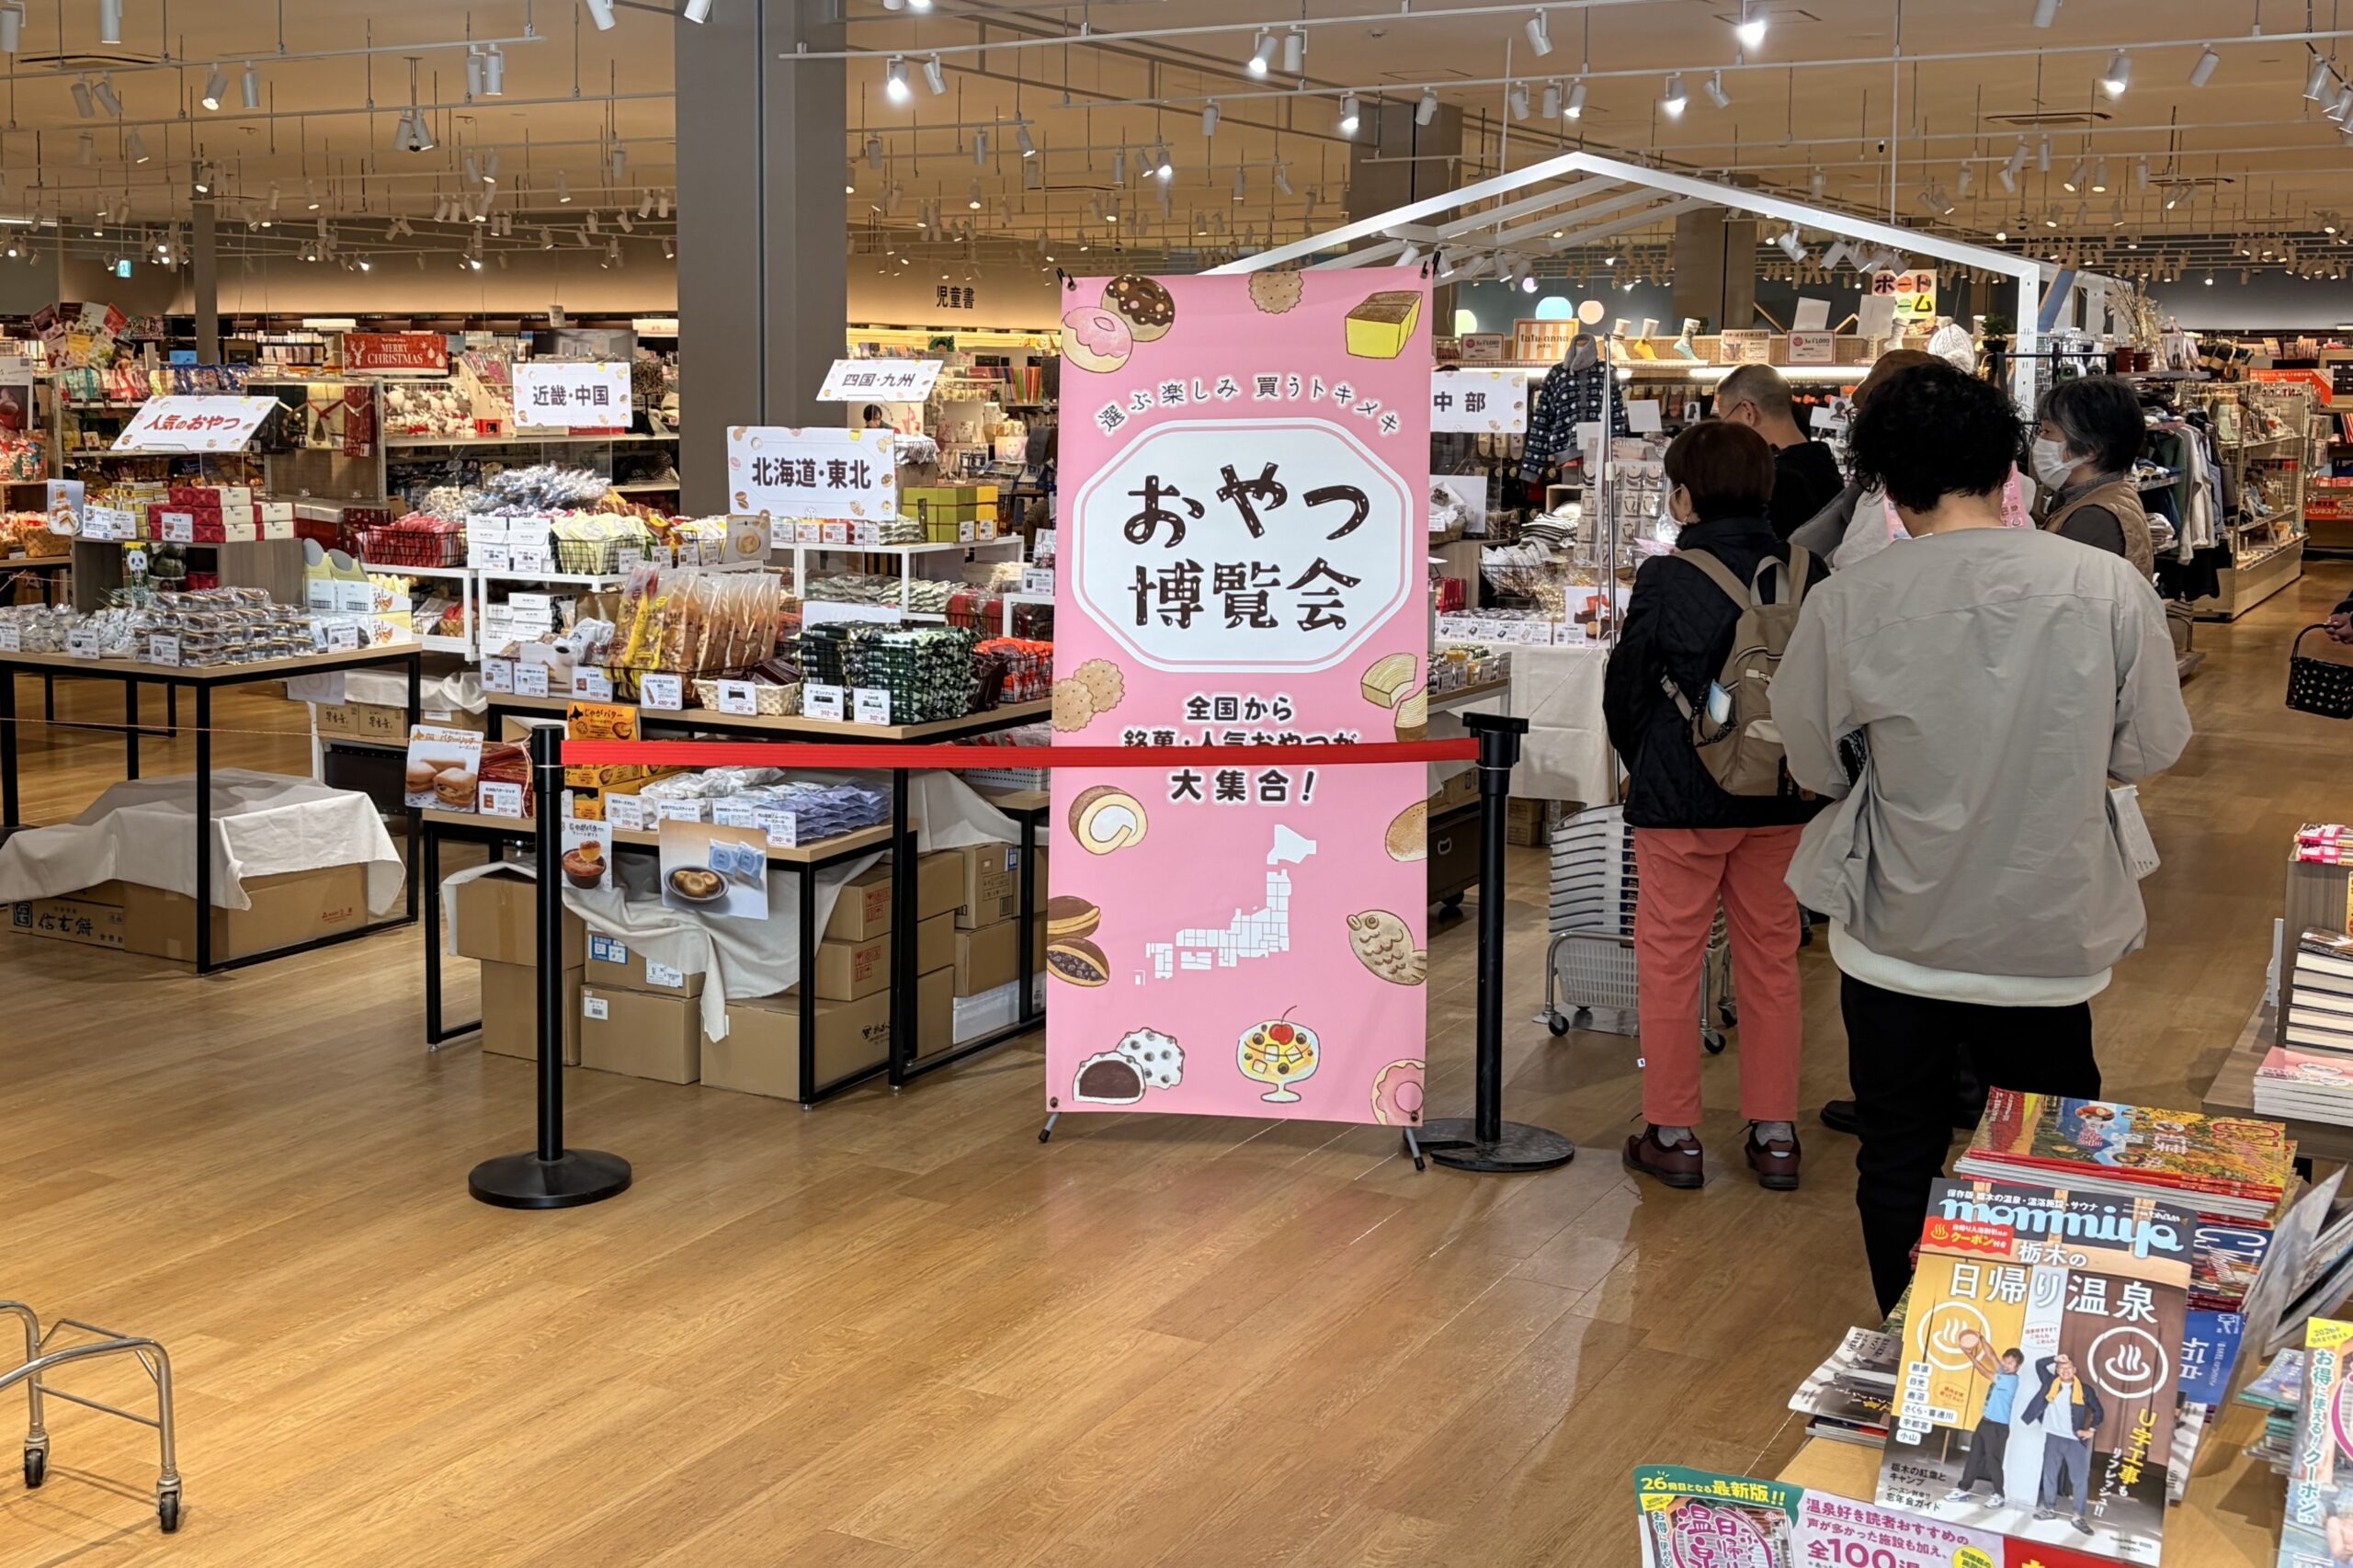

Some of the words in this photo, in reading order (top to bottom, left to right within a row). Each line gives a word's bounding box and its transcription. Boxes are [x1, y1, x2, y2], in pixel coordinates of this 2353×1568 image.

[936, 284, 976, 310] 児童書
[1895, 295, 1933, 312] ーム
[368, 352, 424, 366] CHRISTMAS
[381, 343, 409, 353] MERRY
[841, 370, 916, 388] 四国・九州
[531, 383, 610, 408] 近畿・中国
[1099, 377, 1239, 433] 選ぶ楽しみ
[1256, 376, 1400, 433] 買うトキメキ
[1433, 390, 1486, 413] 中部
[143, 414, 241, 431] 人気のおやつ
[751, 456, 872, 491] 北海道・東北
[1123, 461, 1370, 550] おやつ
[1127, 556, 1362, 632] 博覧会
[1186, 695, 1293, 722] 全国から
[1170, 768, 1317, 803] 大集合!
[2018, 1240, 2087, 1267] 栃木の
[1949, 1262, 2159, 1324] 日帰り温泉
[1900, 1432, 1918, 1442] 小山
[1890, 1472, 1926, 1486] キャンプ
[1886, 1493, 1941, 1511] 忘年会ガイド
[1805, 1497, 1970, 1546] 温泉好き読者おすすめの
[1806, 1517, 1948, 1561] 声が多かった施設も加え、
